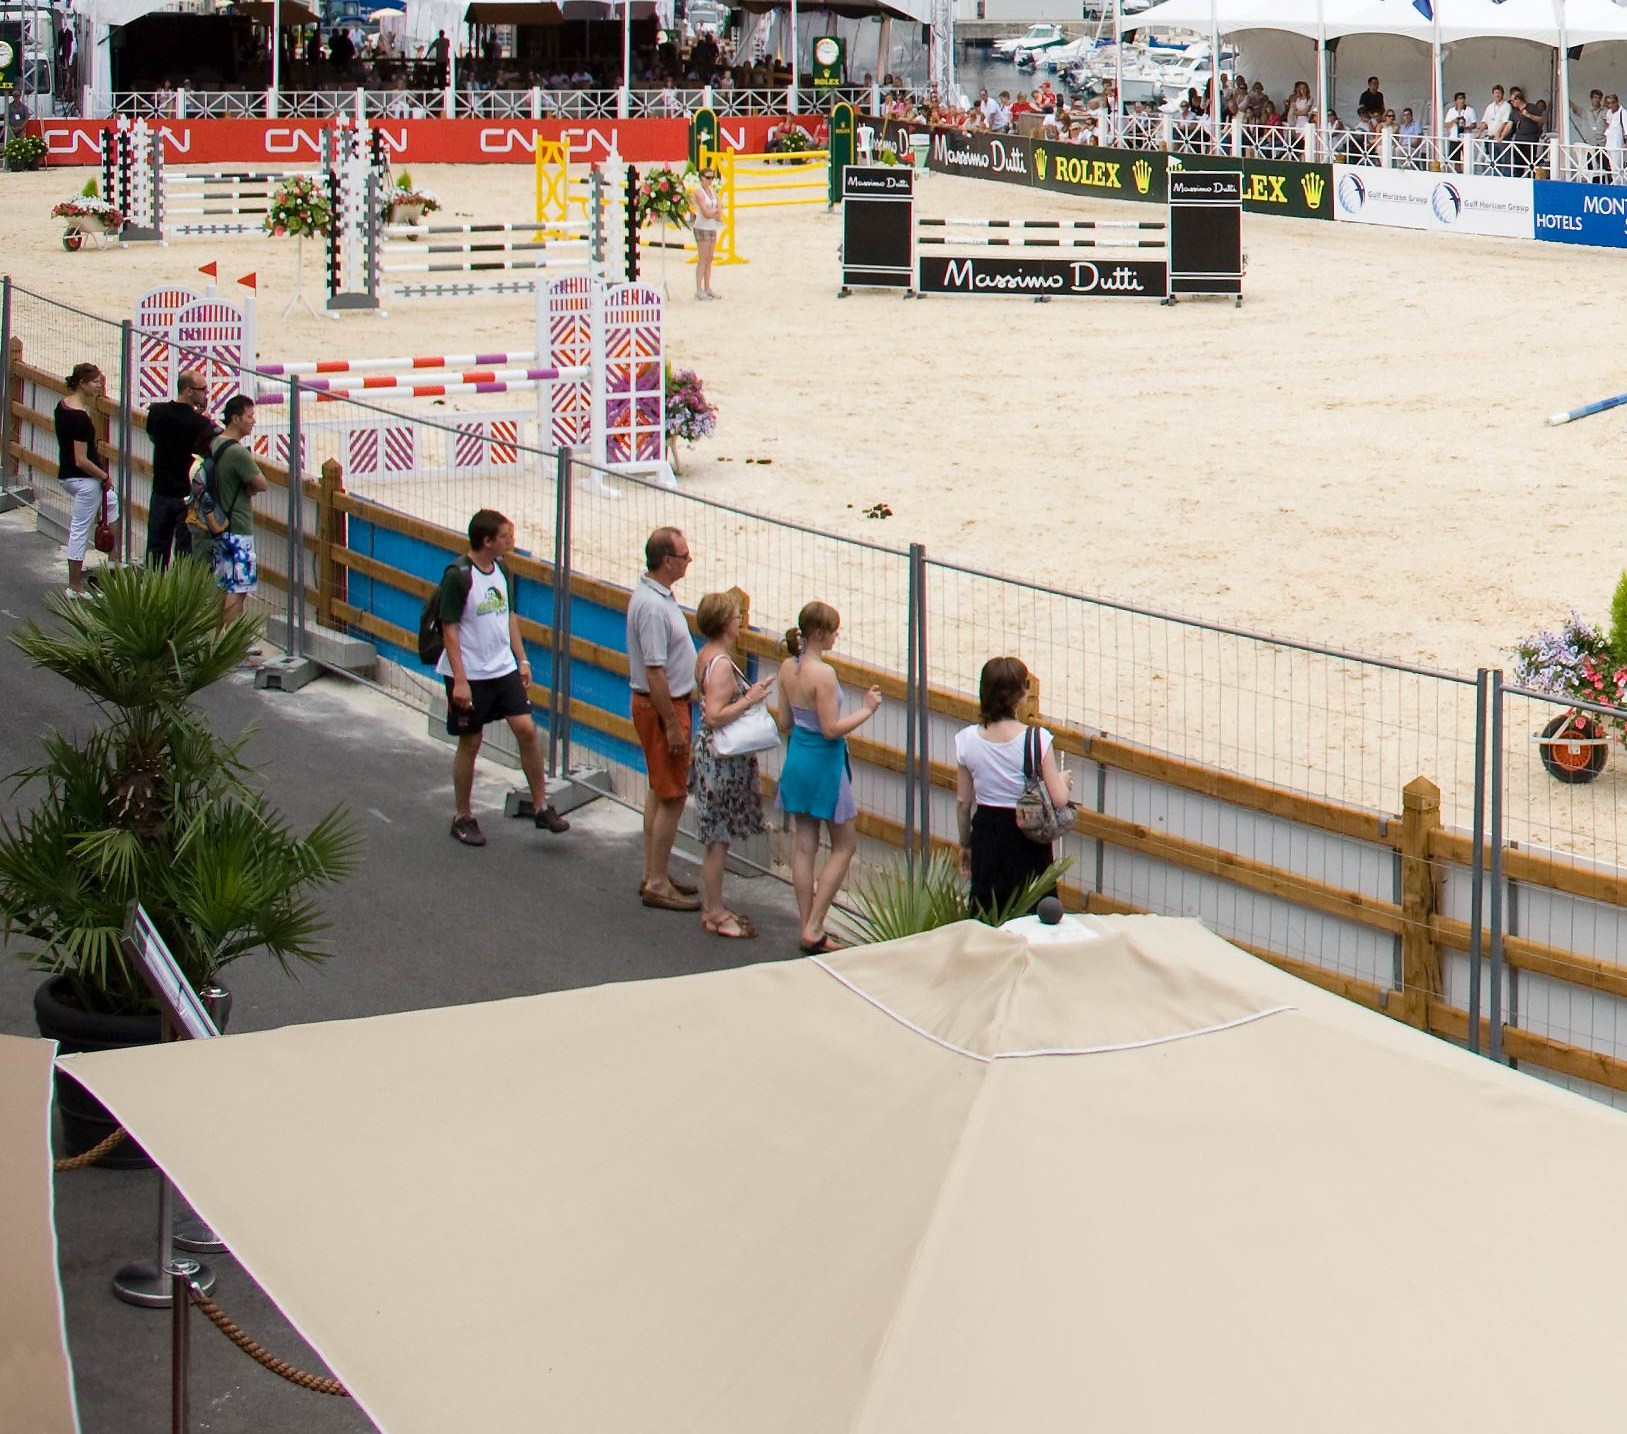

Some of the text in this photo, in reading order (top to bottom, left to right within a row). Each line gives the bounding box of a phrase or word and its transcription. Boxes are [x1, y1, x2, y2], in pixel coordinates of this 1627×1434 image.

[814, 78, 840, 86] ROLEX
[45, 129, 104, 153] CN
[265, 128, 322, 154] CN
[480, 128, 538, 154] CN
[934, 134, 990, 168] Massimo
[990, 139, 1028, 175] Dutti
[847, 176, 910, 188] Massimo Dutti
[1055, 156, 1122, 189] ROLEX
[1173, 182, 1238, 193] Massimo Dutti
[1241, 173, 1288, 203] LEX
[1367, 190, 1382, 200] Gulf
[1408, 194, 1428, 205] Group
[1463, 199, 1477, 209] Gulf
[1507, 203, 1530, 213] Group
[1536, 213, 1583, 231] HOTELS
[943, 259, 1145, 292] Massimo Dutti
